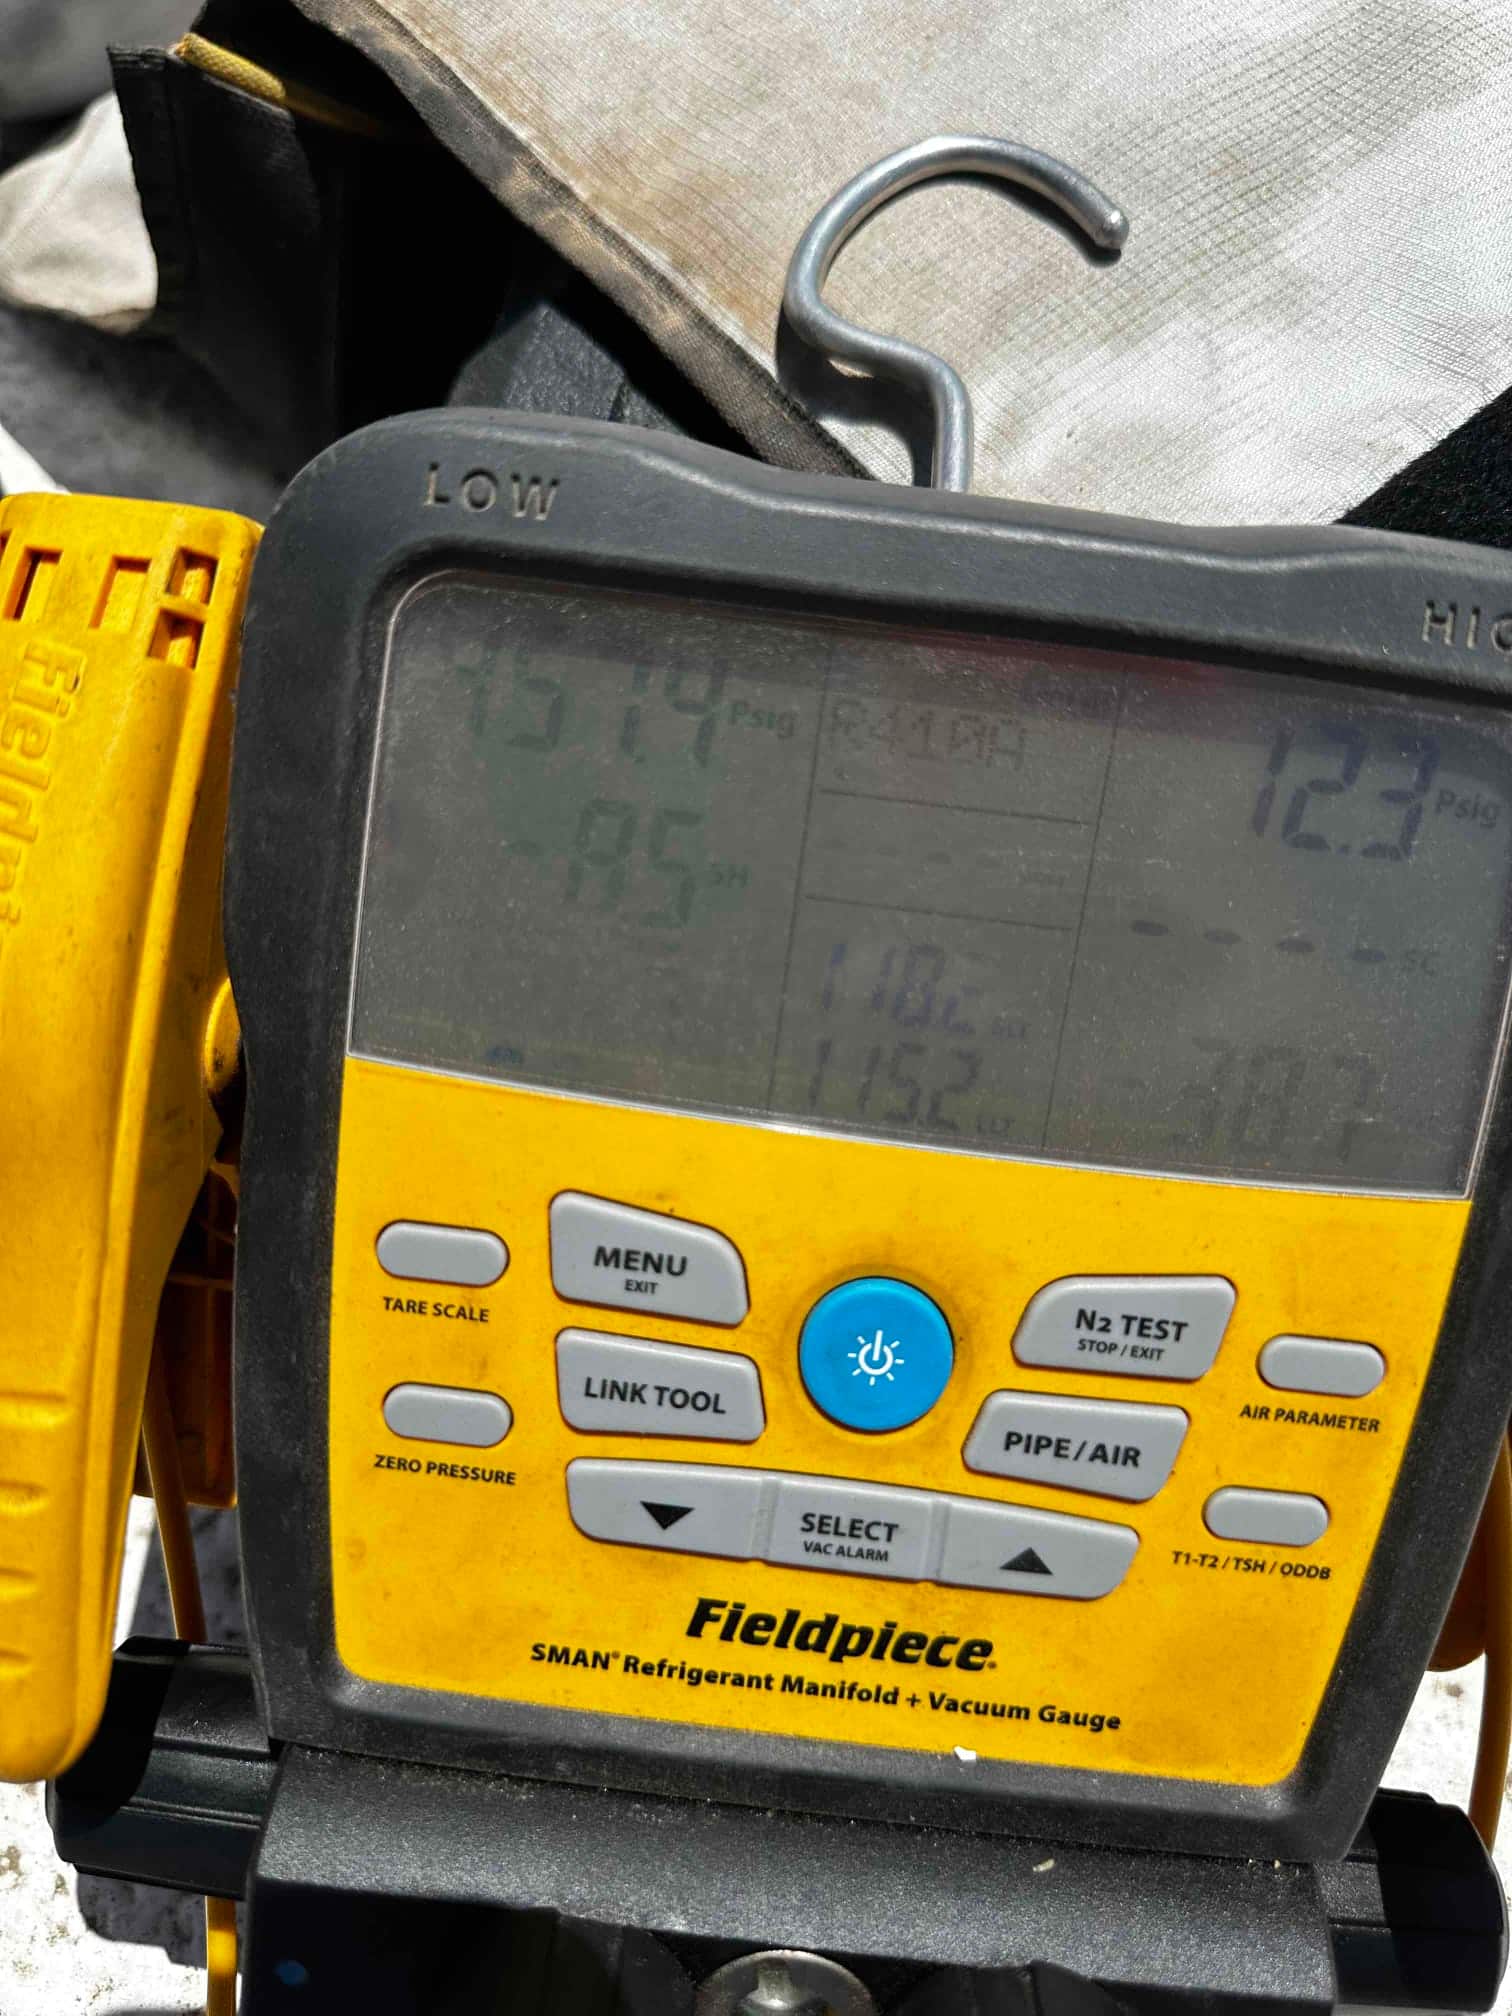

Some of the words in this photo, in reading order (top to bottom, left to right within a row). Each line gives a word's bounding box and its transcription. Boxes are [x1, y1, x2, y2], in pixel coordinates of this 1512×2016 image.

[424, 461, 561, 521] LOW
[1434, 790, 1498, 830] Psig
[593, 1245, 688, 1277] MENU
[623, 1278, 658, 1295] EXIT
[383, 1296, 428, 1316] TARE
[432, 1301, 489, 1322] SCALE
[1074, 1308, 1112, 1334] N2
[1120, 1315, 1188, 1342] TEST
[1077, 1338, 1118, 1356] STOP
[1133, 1344, 1164, 1361] EXIT
[584, 1376, 648, 1405] LINK
[653, 1386, 726, 1415] TOOL
[1239, 1404, 1270, 1422] AIR
[1273, 1407, 1380, 1433] PARAMETER
[374, 1454, 422, 1474] ZERO
[426, 1461, 516, 1486] PRESSURE
[801, 1512, 898, 1543] SELECT
[803, 1541, 833, 1556] VAC
[835, 1545, 889, 1562] ALARM
[1171, 1550, 1218, 1568] T1-T2
[1233, 1559, 1265, 1575] TSH
[1280, 1562, 1331, 1581] ODDB
[685, 1598, 997, 1672] Fieldpiece
[623, 1655, 774, 1692] Refrigerant
[781, 1674, 899, 1706] Manifold
[928, 1692, 1031, 1720] Vacuum
[1038, 1704, 1121, 1731] Gauge
